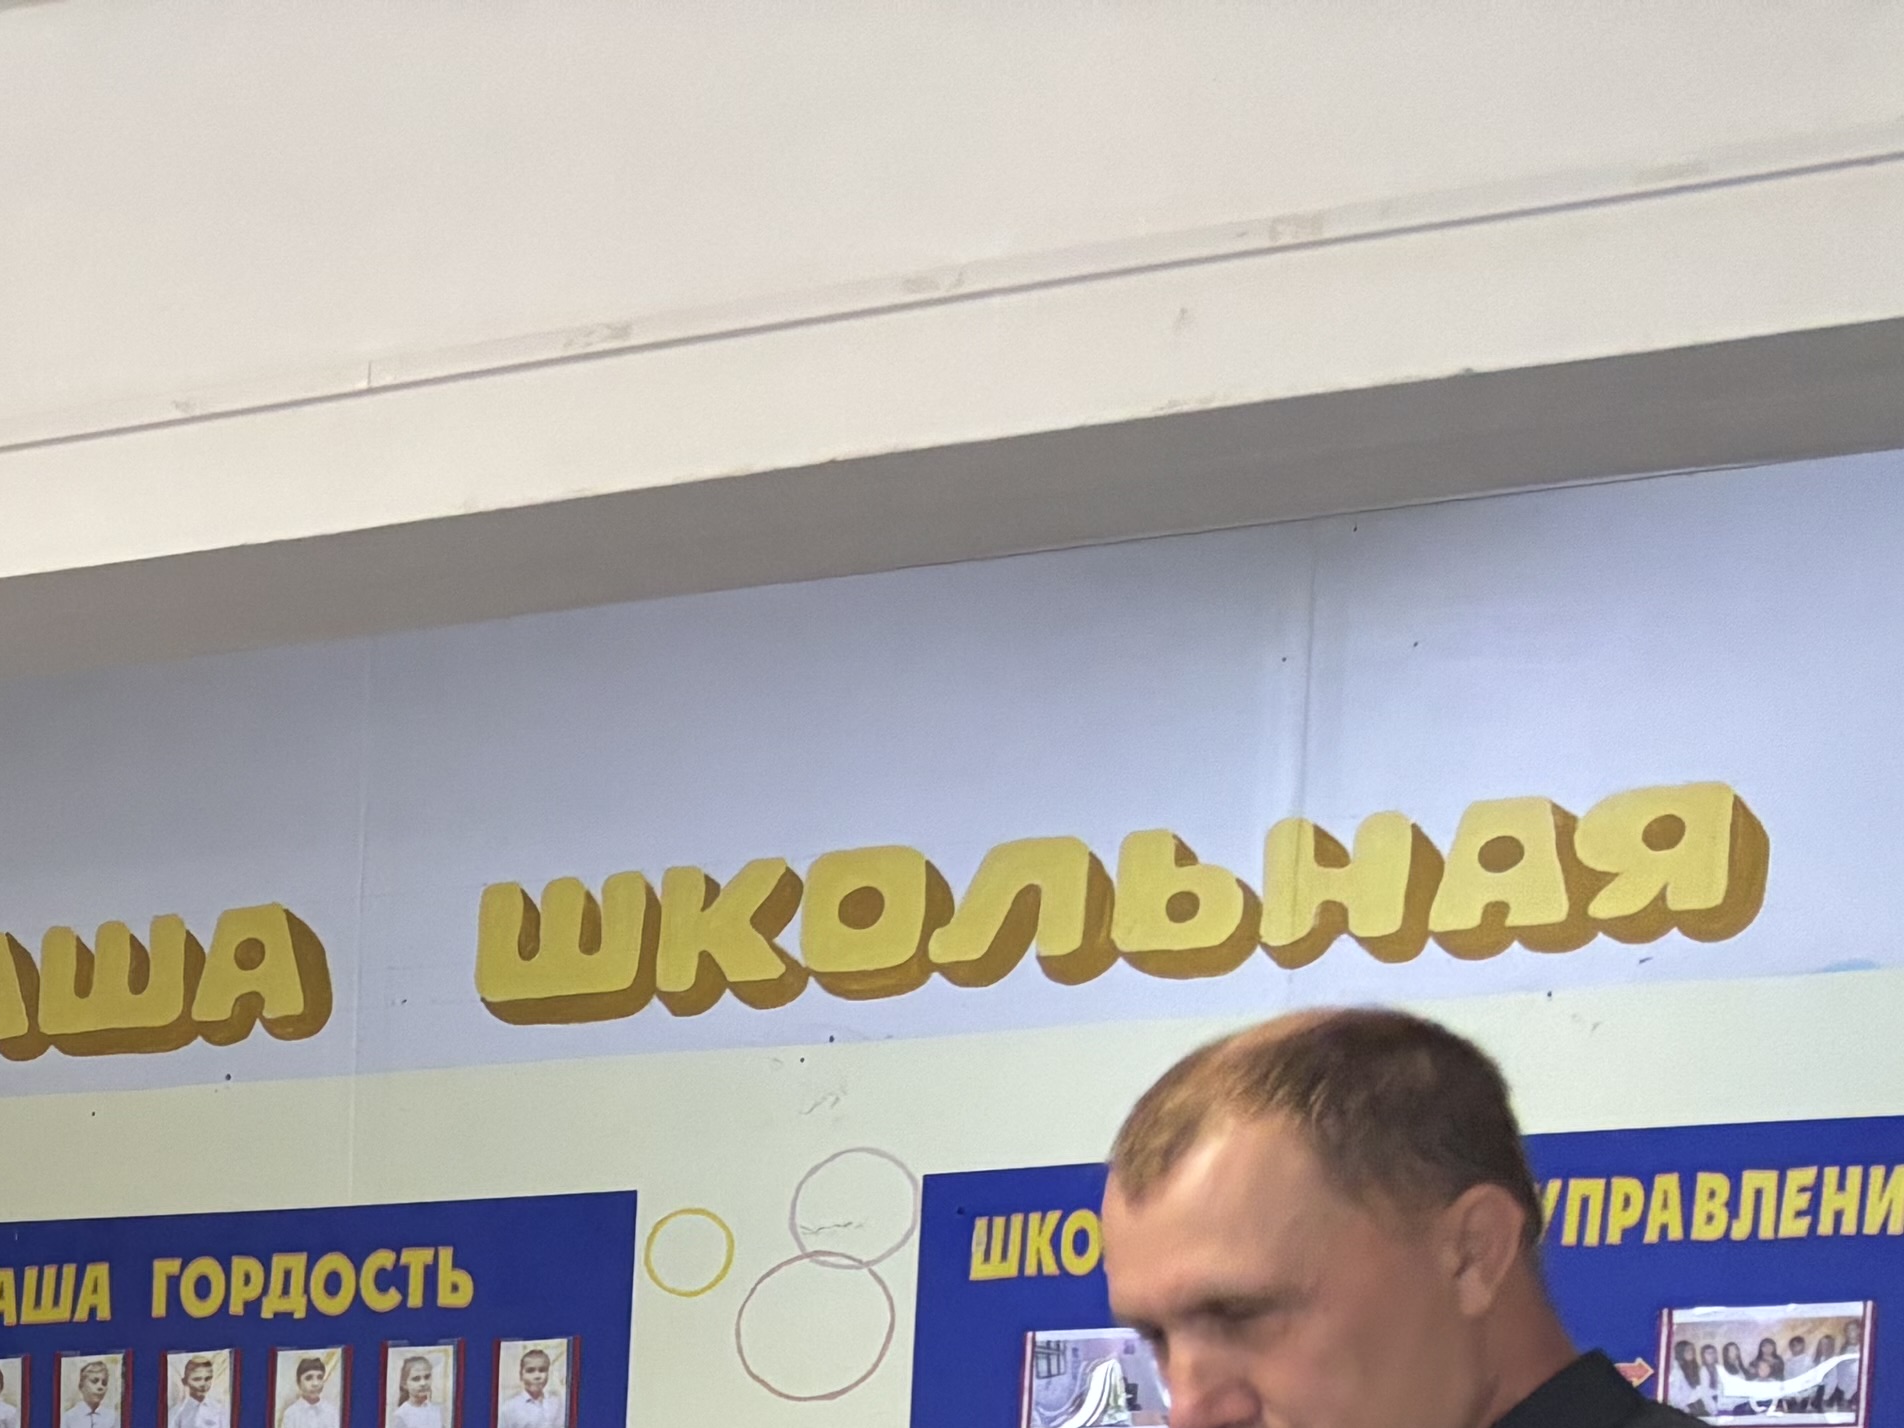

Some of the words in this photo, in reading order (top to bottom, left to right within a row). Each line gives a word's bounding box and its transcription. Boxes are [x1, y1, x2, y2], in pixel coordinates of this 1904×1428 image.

[475, 781, 1770, 1026] ШКОЛЬНАЯ
[969, 1210, 1106, 1278] ШКО
[1537, 1164, 1904, 1248] УПРАВЛЕНИ
[151, 1244, 474, 1319] ГОРДОСТЬ
